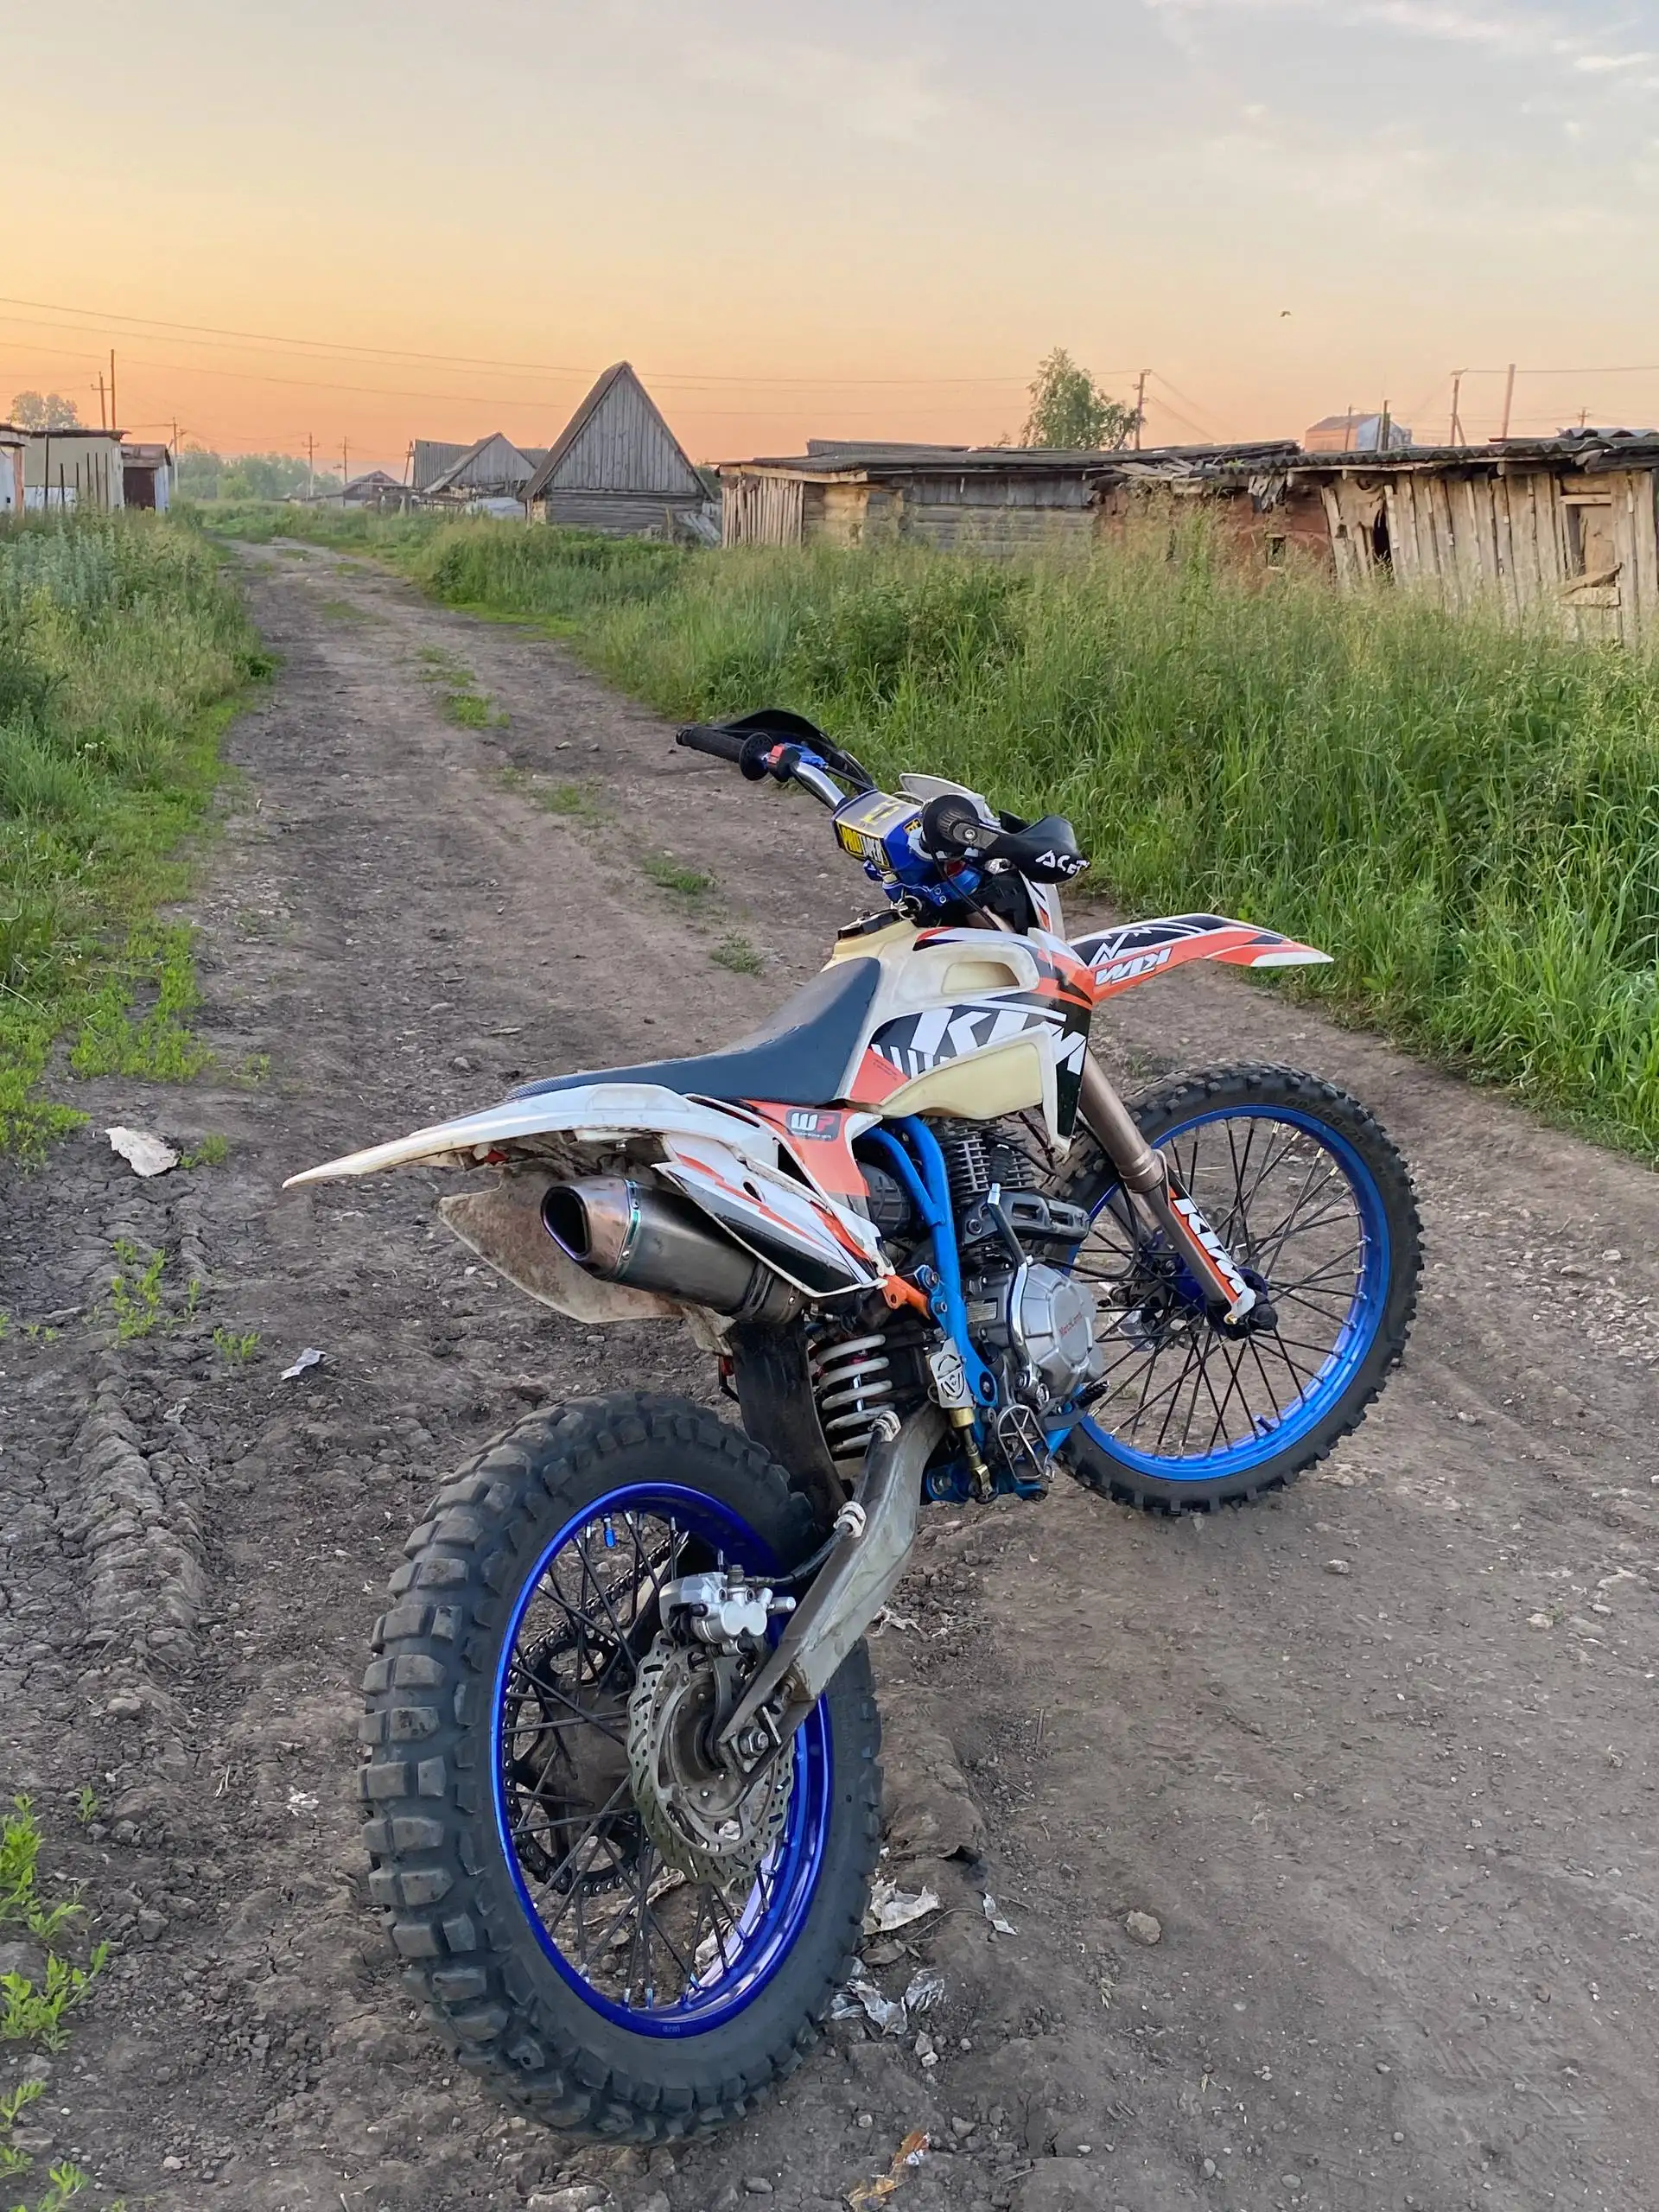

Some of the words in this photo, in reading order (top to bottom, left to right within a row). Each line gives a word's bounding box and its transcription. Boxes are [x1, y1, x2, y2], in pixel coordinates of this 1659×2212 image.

[1095, 947, 1173, 985] KTM
[791, 1112, 835, 1134] WP
[1173, 1198, 1245, 1294] KTM
